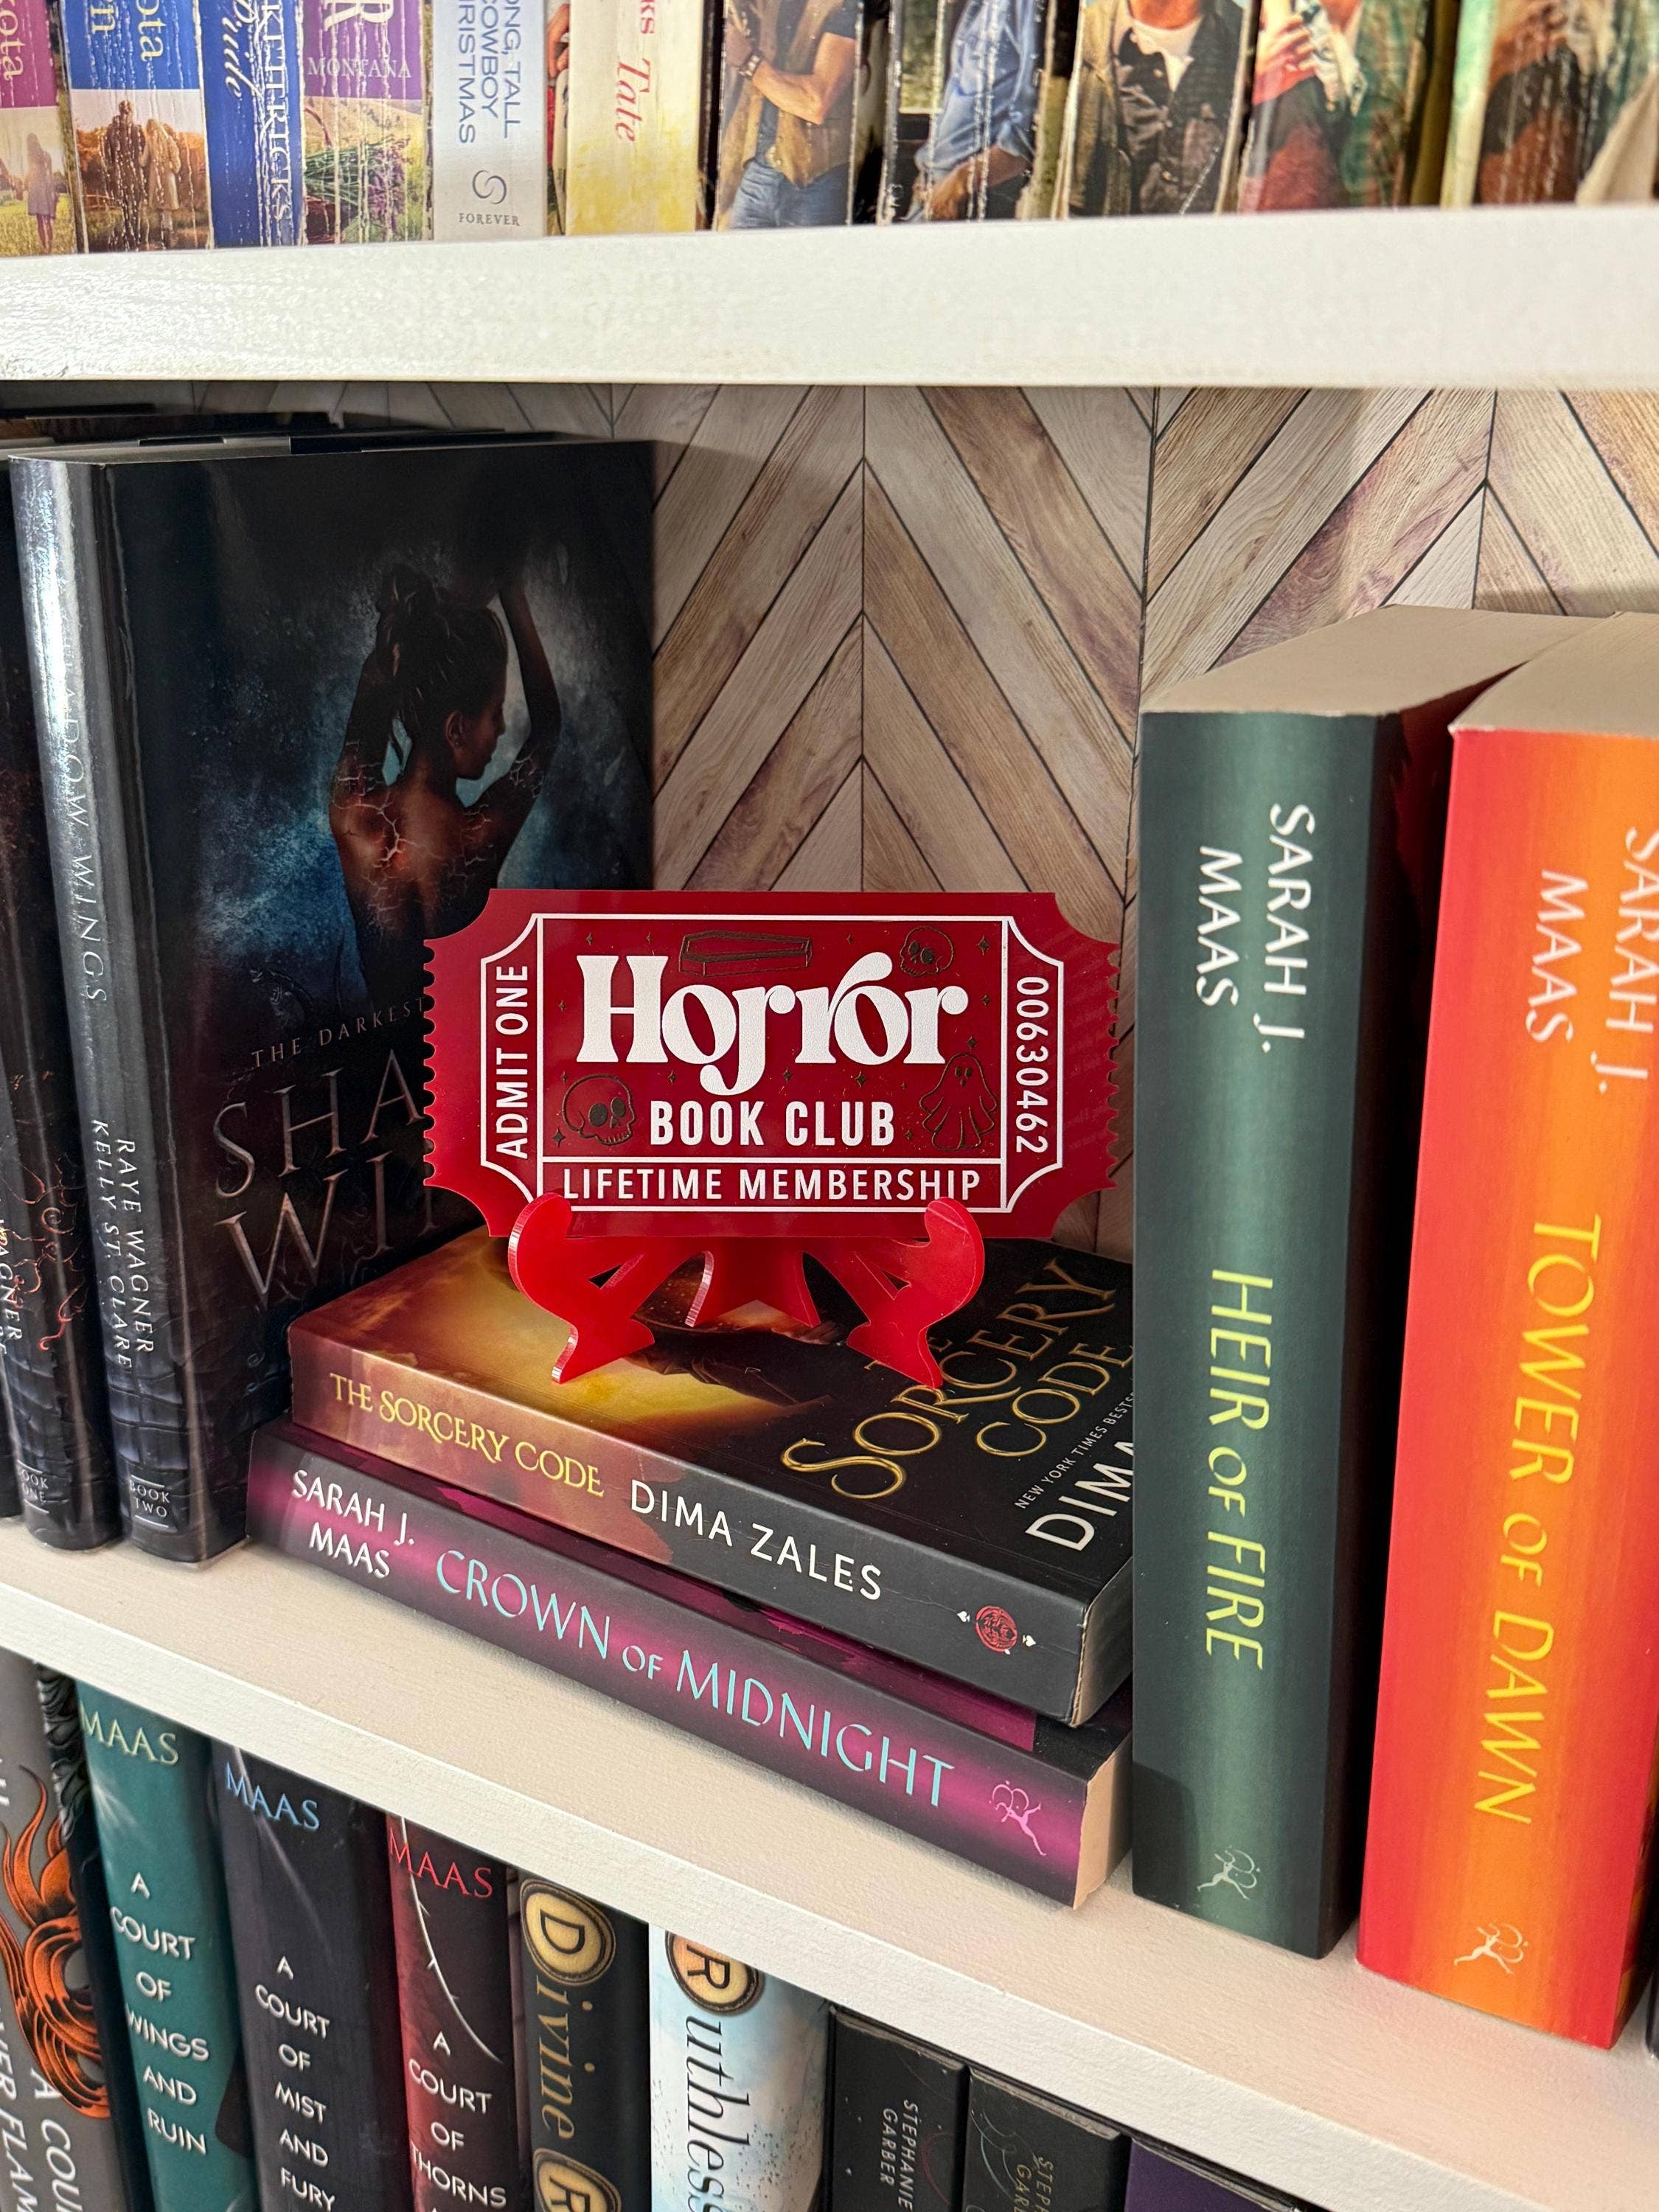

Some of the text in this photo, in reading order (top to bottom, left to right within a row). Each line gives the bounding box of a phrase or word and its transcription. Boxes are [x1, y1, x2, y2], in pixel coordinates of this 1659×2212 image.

[0, 0, 25, 80] ota
[307, 57, 412, 78] MONTANA
[458, 0, 476, 144] RISTMAS
[480, 0, 499, 118] OWBOY
[496, 0, 521, 139] NG, TALL
[614, 58, 652, 141] Tate
[459, 213, 521, 226] FOREVER
[72, 852, 108, 1002] WINGS
[1196, 845, 1243, 1006] MAAS
[1253, 804, 1316, 1053] SARAH J.
[1525, 869, 1589, 1043] MAAS
[1590, 827, 1659, 1096] SARAH J.
[251, 1038, 301, 1068] THE
[495, 964, 528, 1159] ADMIT ONE
[575, 951, 968, 1096] Horror
[1015, 976, 1048, 1154] 00630462
[650, 1101, 894, 1146] BOOK CLUB
[563, 1168, 981, 1201] LIFETIME MEMBERSHIP
[90, 1119, 133, 1370] KELLY ST. CLARE
[115, 1138, 155, 1354] RAYE WAGNER
[780, 1258, 1117, 1500] SORCERY
[976, 1343, 1133, 1458] CODE
[330, 1372, 605, 1498] THE SORCERY CODE
[1014, 1484, 1045, 1509] NEW
[1040, 1456, 1077, 1484] YORK
[1071, 1425, 1108, 1456] TIMES
[1206, 1269, 1273, 1670] HEIR OF FIRE
[129, 1479, 170, 1504] BOOK
[133, 1498, 167, 1518] TWO
[292, 1470, 415, 1546] SARAH J.
[1474, 1214, 1602, 1825] TOWER OF DAWN
[309, 1522, 391, 1579] MAAS
[630, 1479, 883, 1601] DIMA ZALES
[437, 1550, 956, 1807] CROWN OF MIDNIGHT
[79, 1705, 179, 1767] MAAS
[225, 1761, 320, 1832] MAAS
[131, 1871, 150, 1899] A
[388, 1827, 494, 1899] MAAS
[109, 1906, 195, 1961] COURT
[276, 1956, 294, 1980] A
[136, 1971, 172, 2003] OF
[255, 1984, 330, 2040] COURT
[536, 1908, 595, 2140] Divine
[126, 2003, 210, 2062] WINGS
[278, 2043, 311, 2073] OF
[433, 2031, 451, 2057] A
[142, 2065, 198, 2106] AND
[274, 2082, 327, 2124] MIST
[408, 2058, 493, 2115] COURT
[30, 2067, 83, 2212] A COU
[147, 2107, 207, 2156] RUIN
[279, 2129, 330, 2168] AND
[430, 2121, 465, 2152] OF
[880, 2108, 899, 2188] GARBER
[898, 2099, 919, 2212] STEPHANIE
[280, 2168, 335, 2212] FURY
[410, 2140, 507, 2208] THORNS
